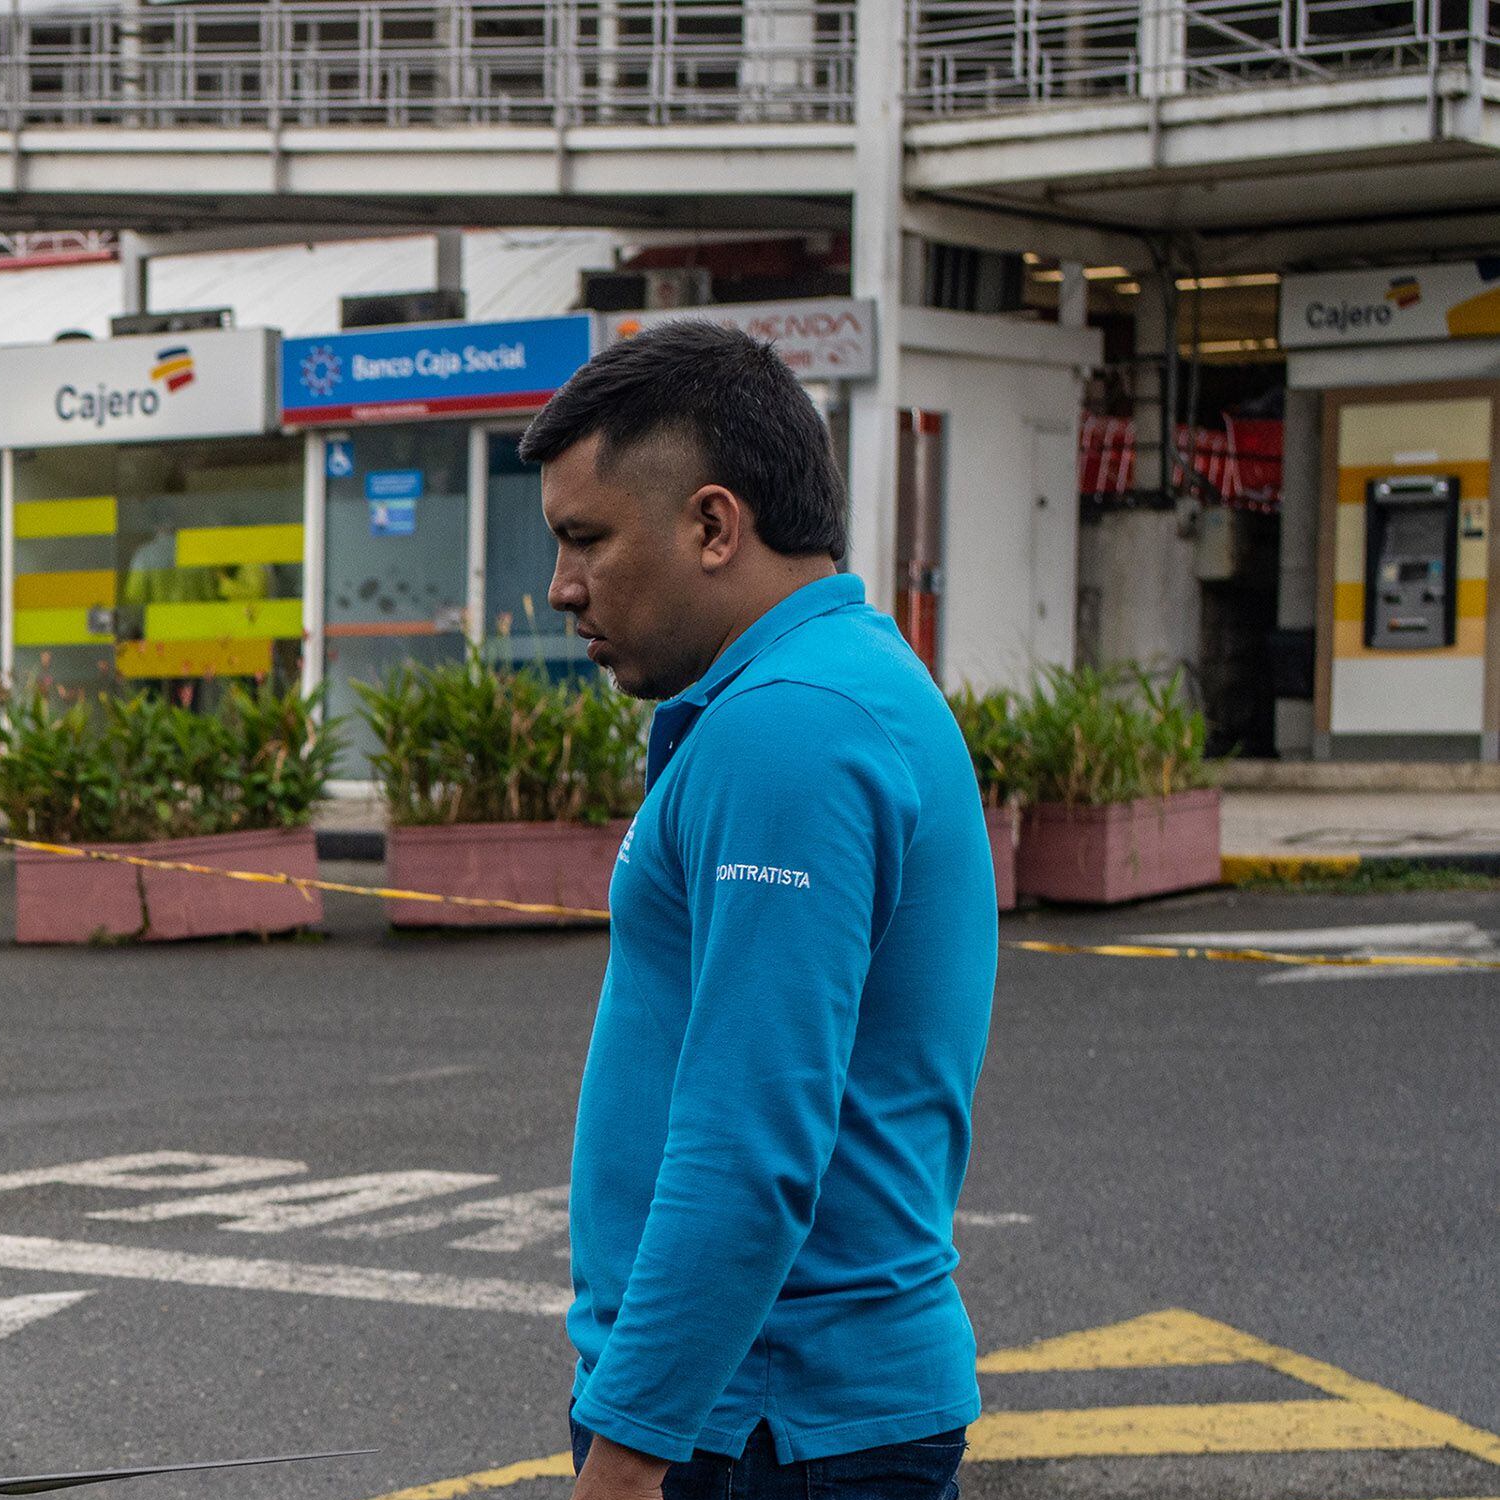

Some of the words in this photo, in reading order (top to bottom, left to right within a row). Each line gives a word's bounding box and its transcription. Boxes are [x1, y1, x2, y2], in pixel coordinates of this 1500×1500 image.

[1305, 300, 1392, 335] Cajero
[352, 354, 414, 381] Banco
[414, 347, 463, 379] Caja
[462, 341, 527, 373] Social
[55, 383, 160, 426] Cajero
[715, 863, 811, 889] CONTRATISTA
